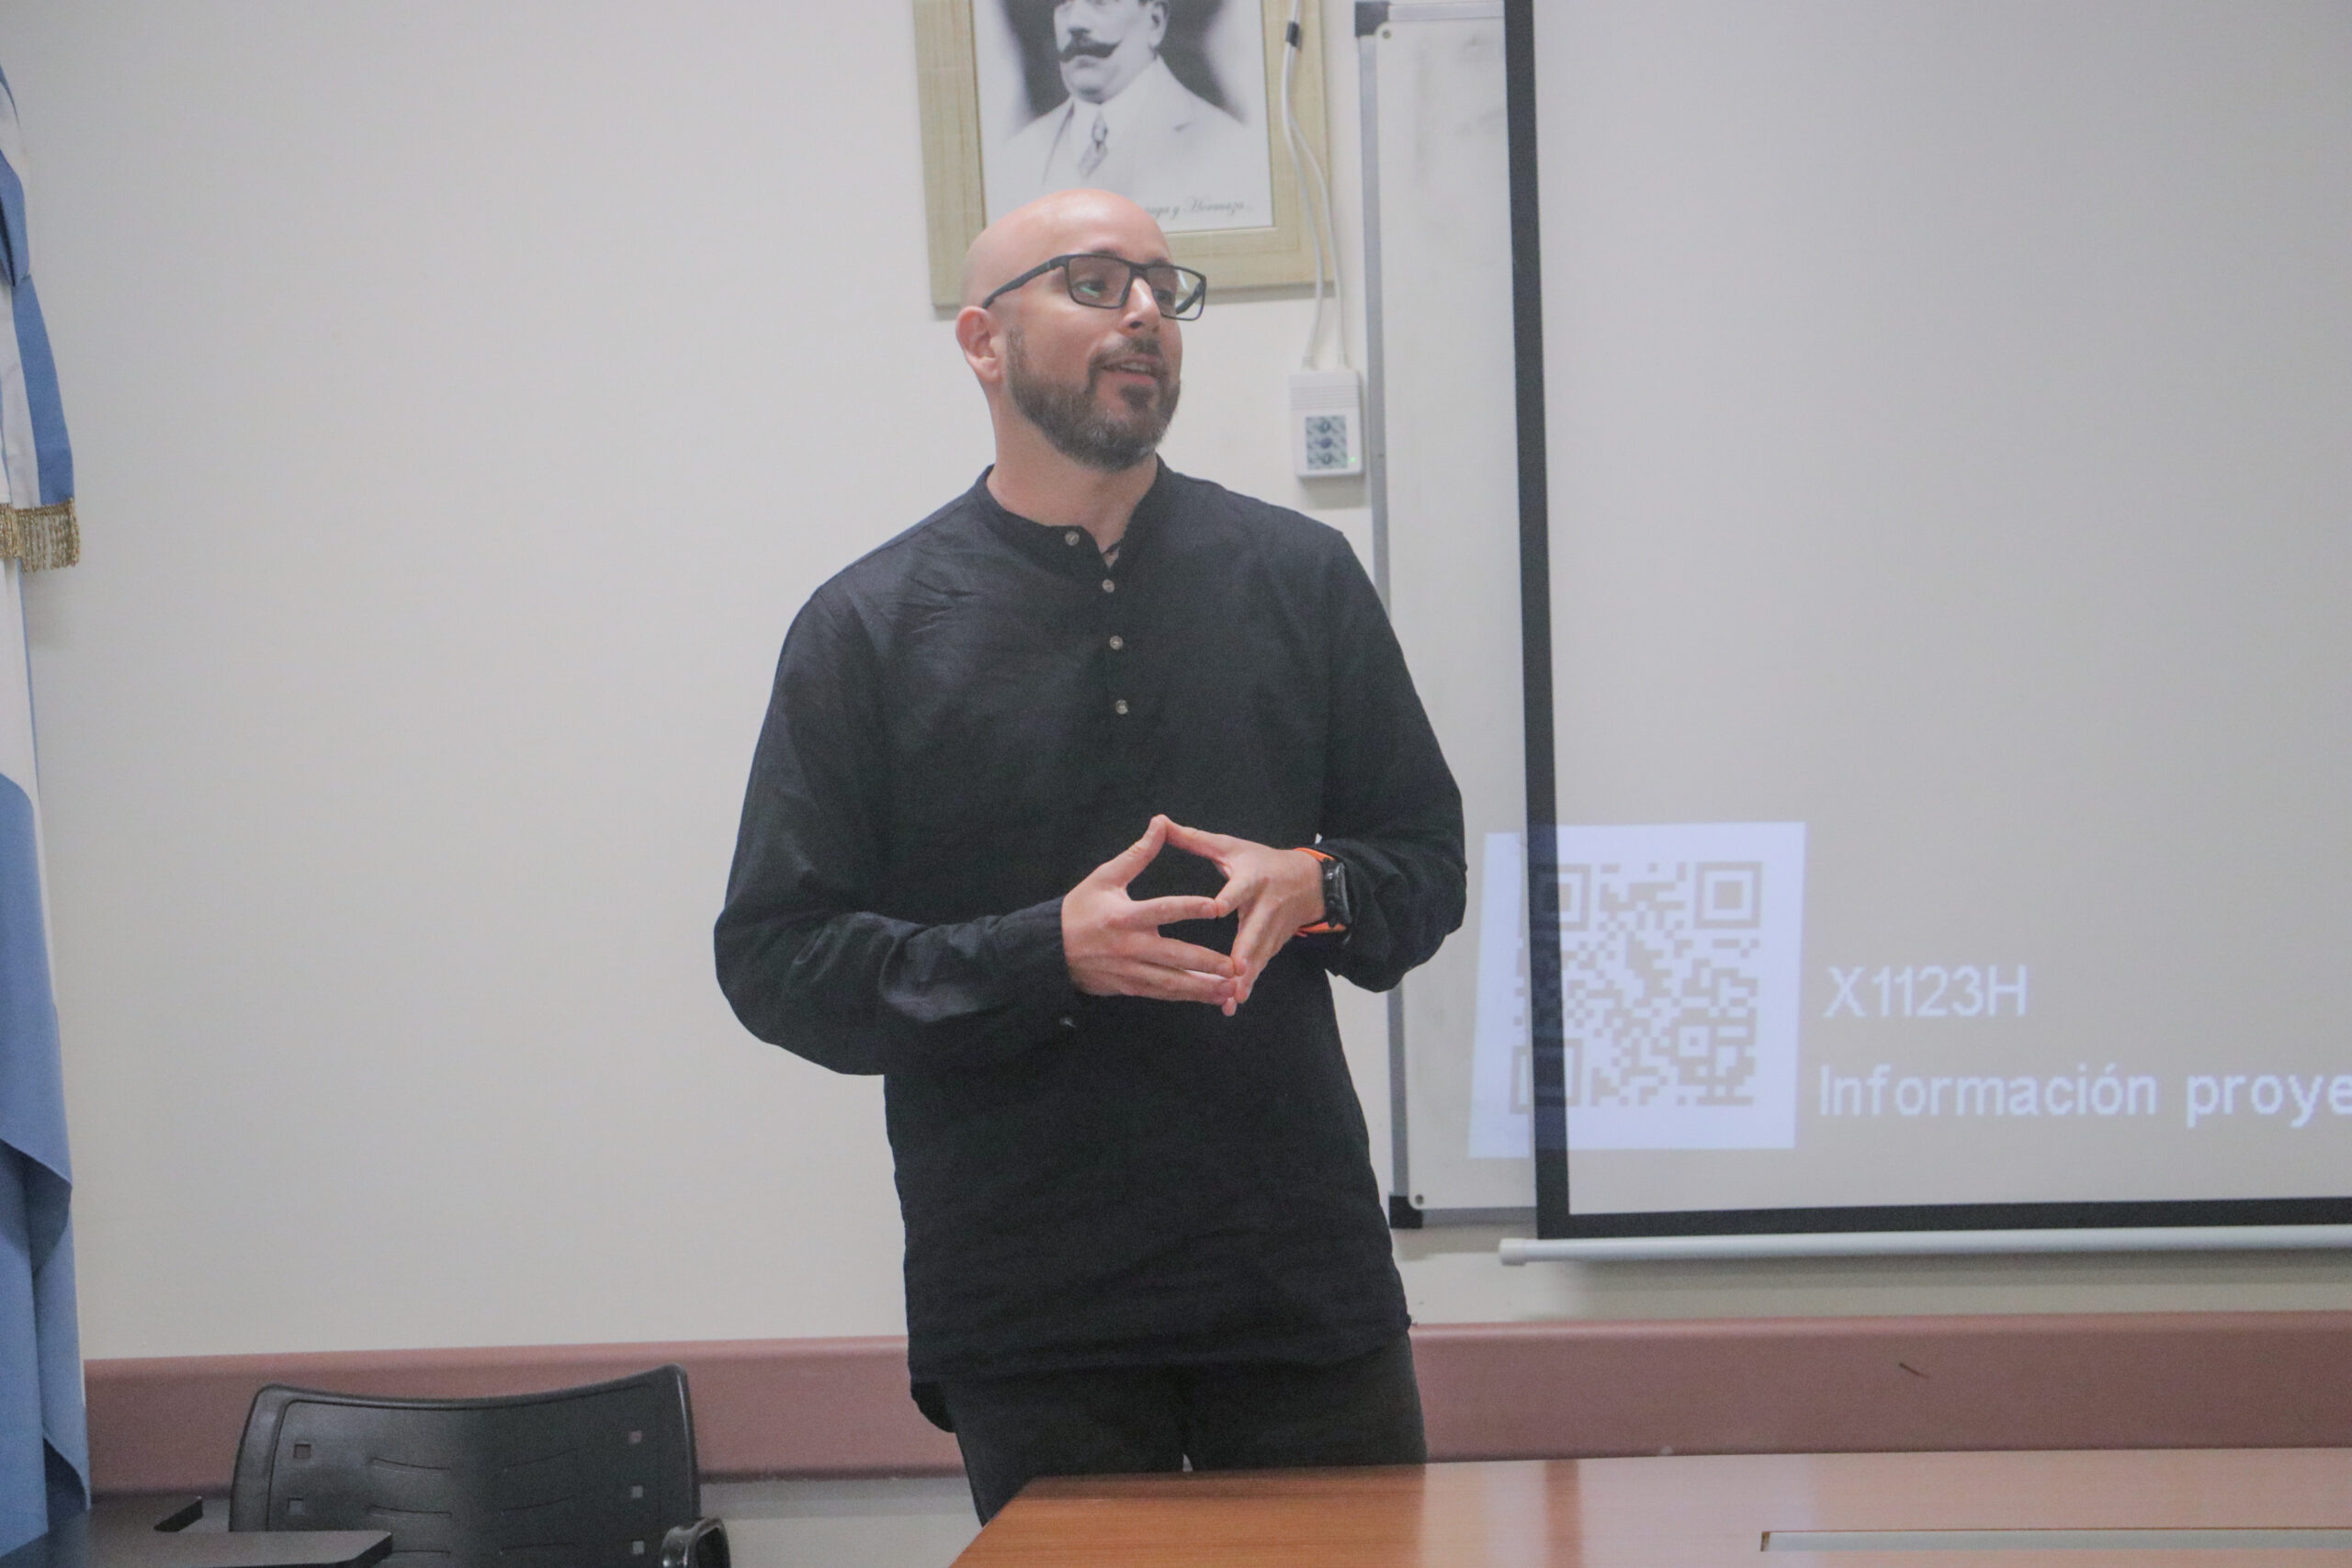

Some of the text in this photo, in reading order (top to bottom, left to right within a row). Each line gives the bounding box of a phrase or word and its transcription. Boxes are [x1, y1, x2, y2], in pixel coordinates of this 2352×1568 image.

[1824, 964, 2028, 1017] X1123H
[1819, 1063, 2352, 1128] Información proye
